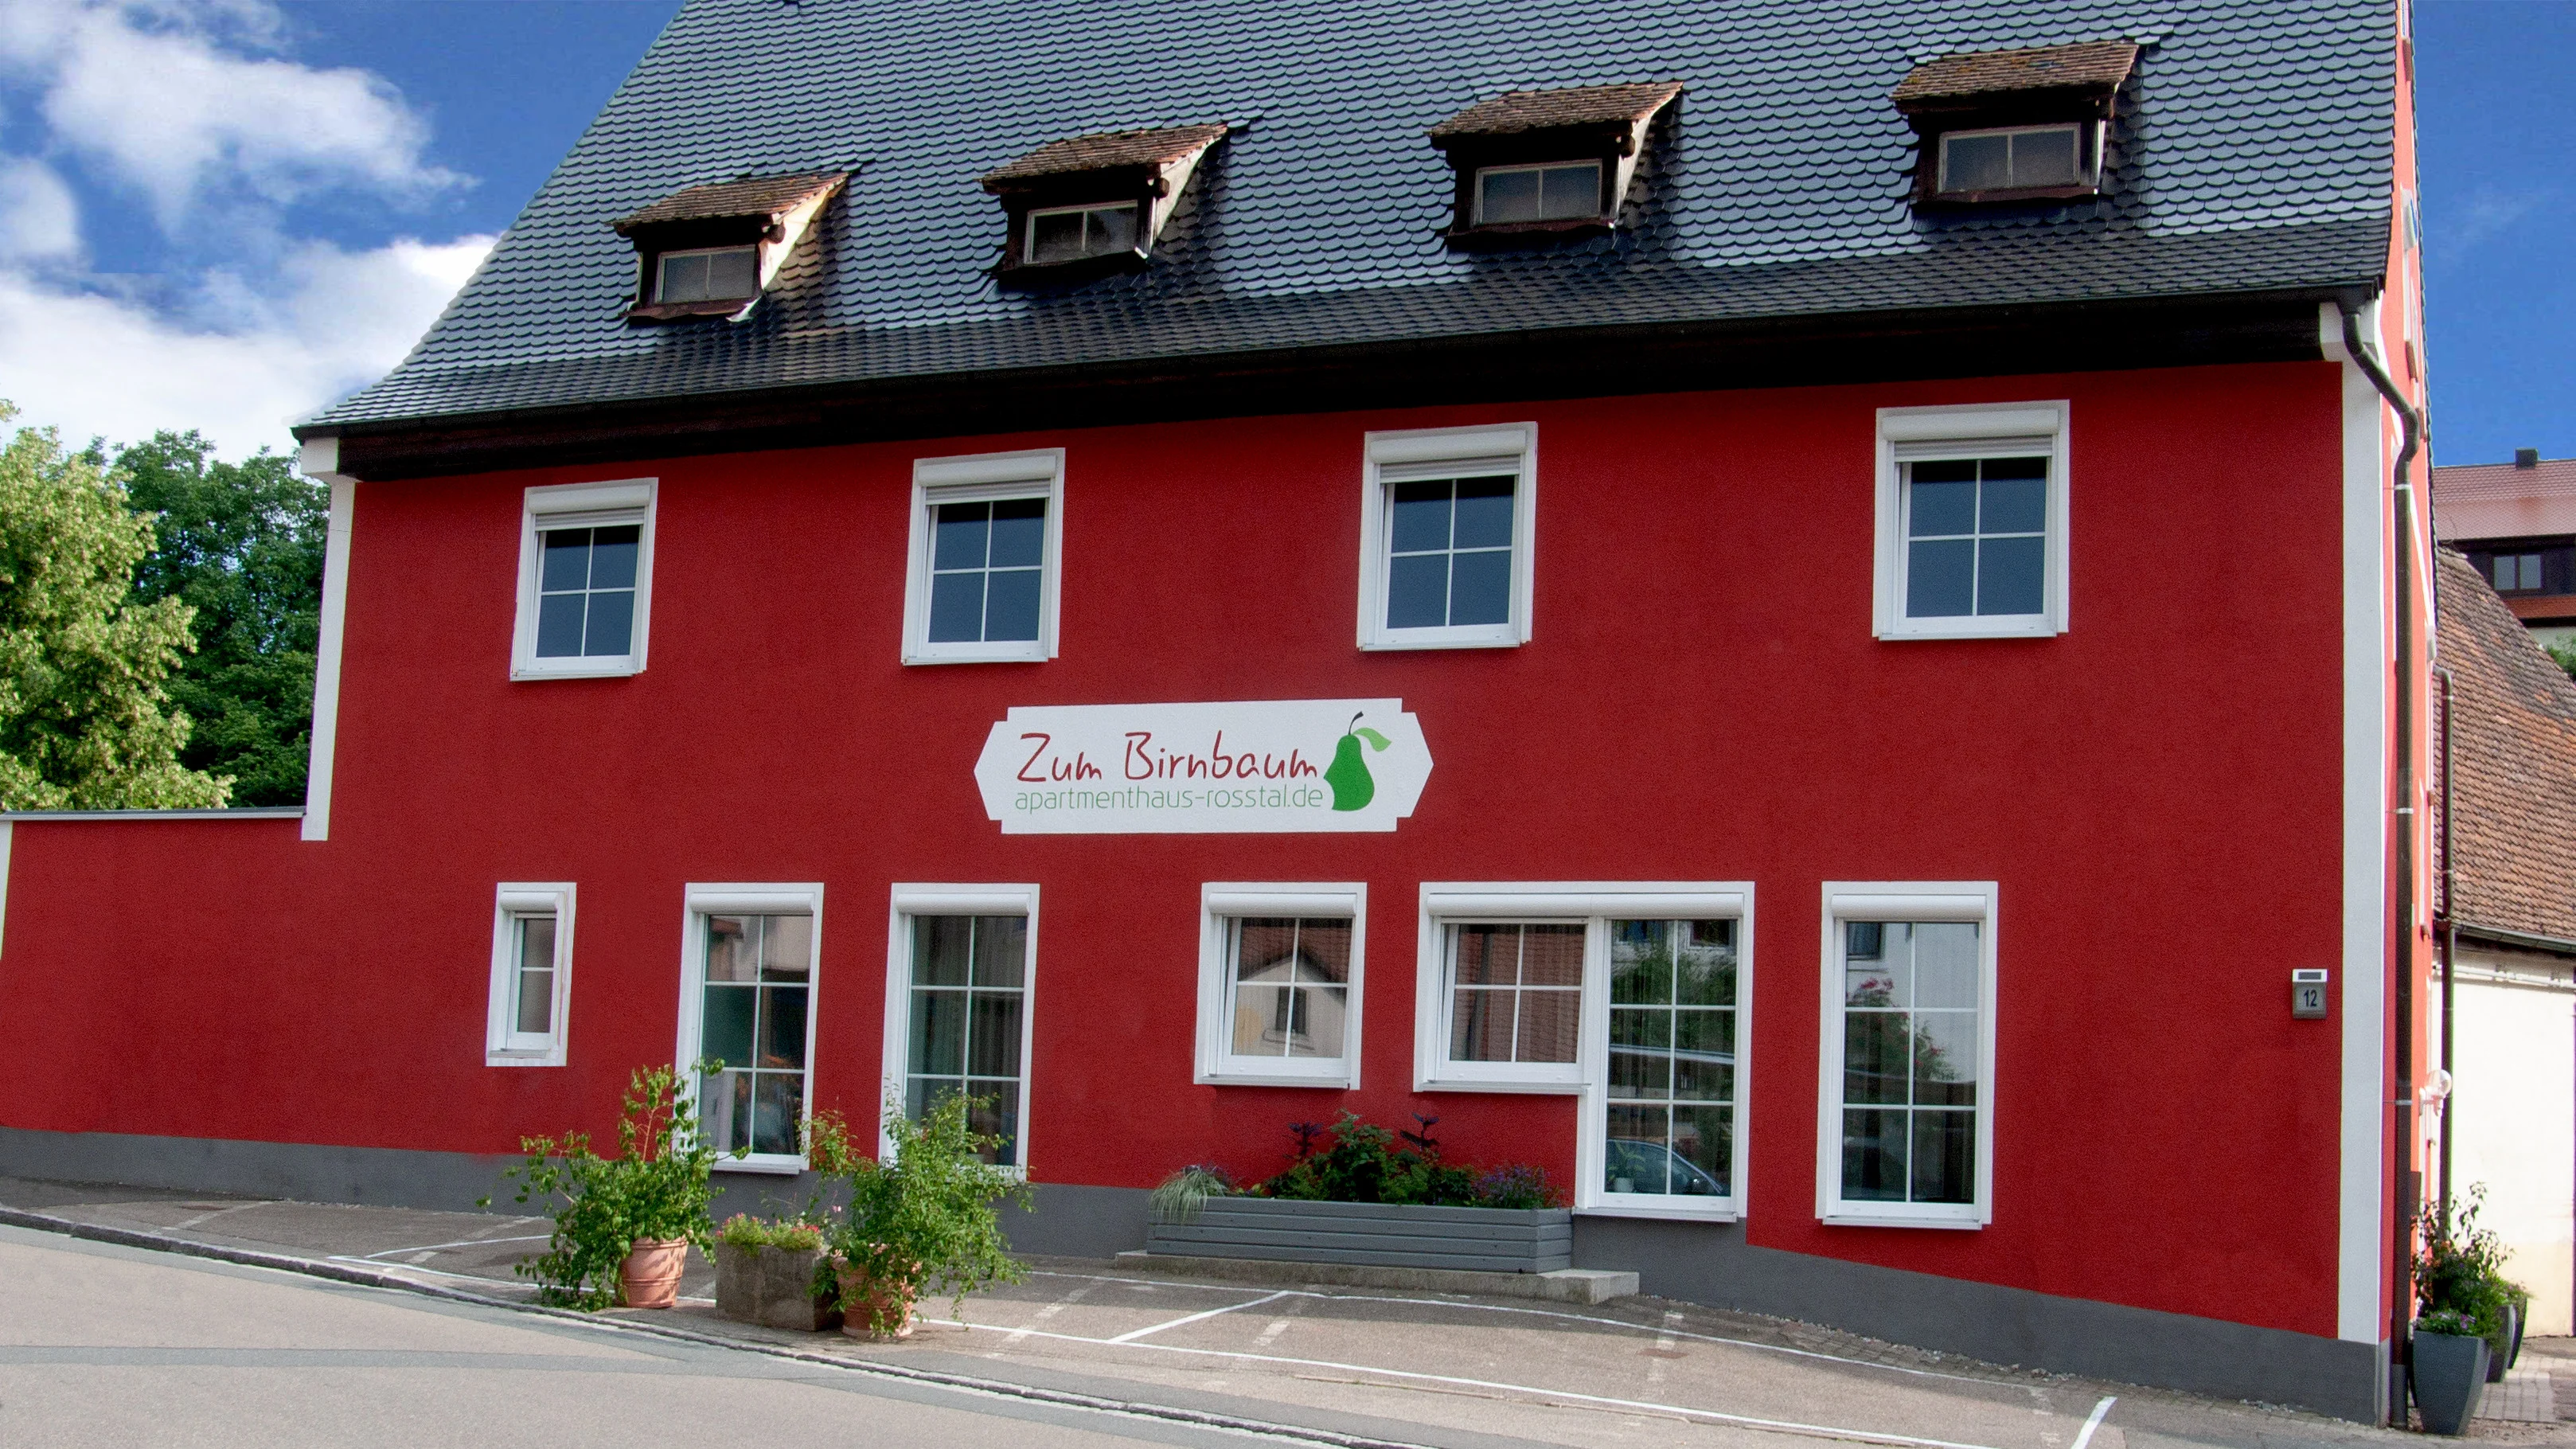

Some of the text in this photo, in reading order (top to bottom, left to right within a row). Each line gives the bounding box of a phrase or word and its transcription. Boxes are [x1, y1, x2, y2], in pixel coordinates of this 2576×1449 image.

[1017, 729, 1317, 783] Zum Birnbaum
[1015, 784, 1323, 814] apartmenthaus-rosstal.de
[2303, 989, 2317, 1007] 12
